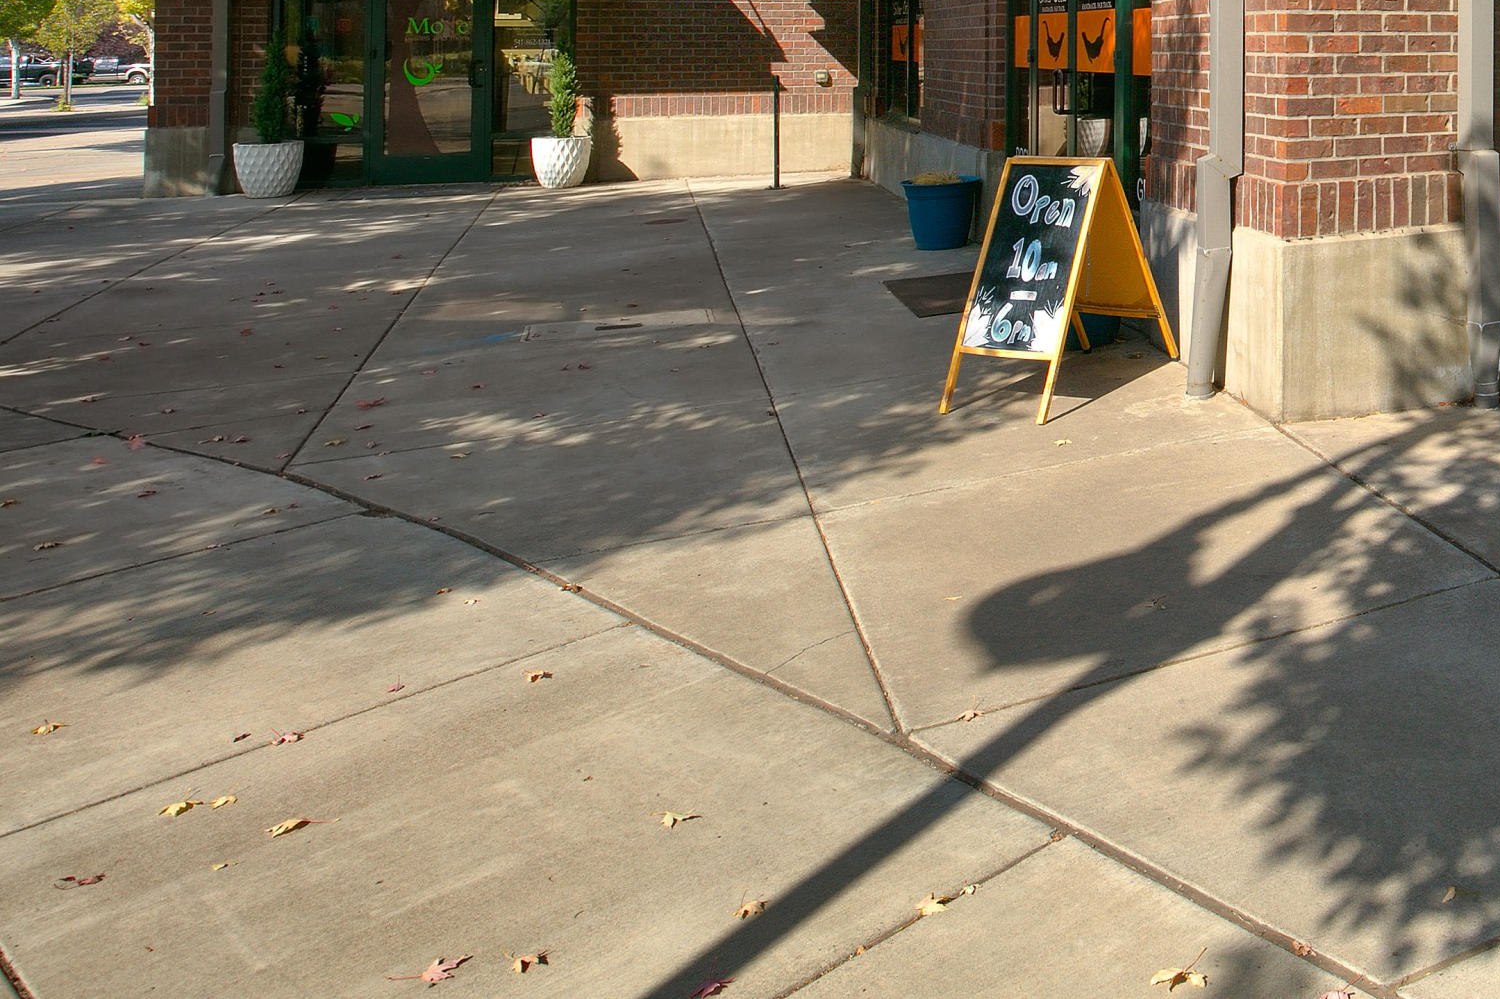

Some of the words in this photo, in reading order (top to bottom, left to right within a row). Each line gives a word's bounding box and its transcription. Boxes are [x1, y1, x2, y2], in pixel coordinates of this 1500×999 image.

[1011, 174, 1076, 228] Open
[1006, 237, 1058, 283] 10am
[991, 302, 1032, 345] 6pm
